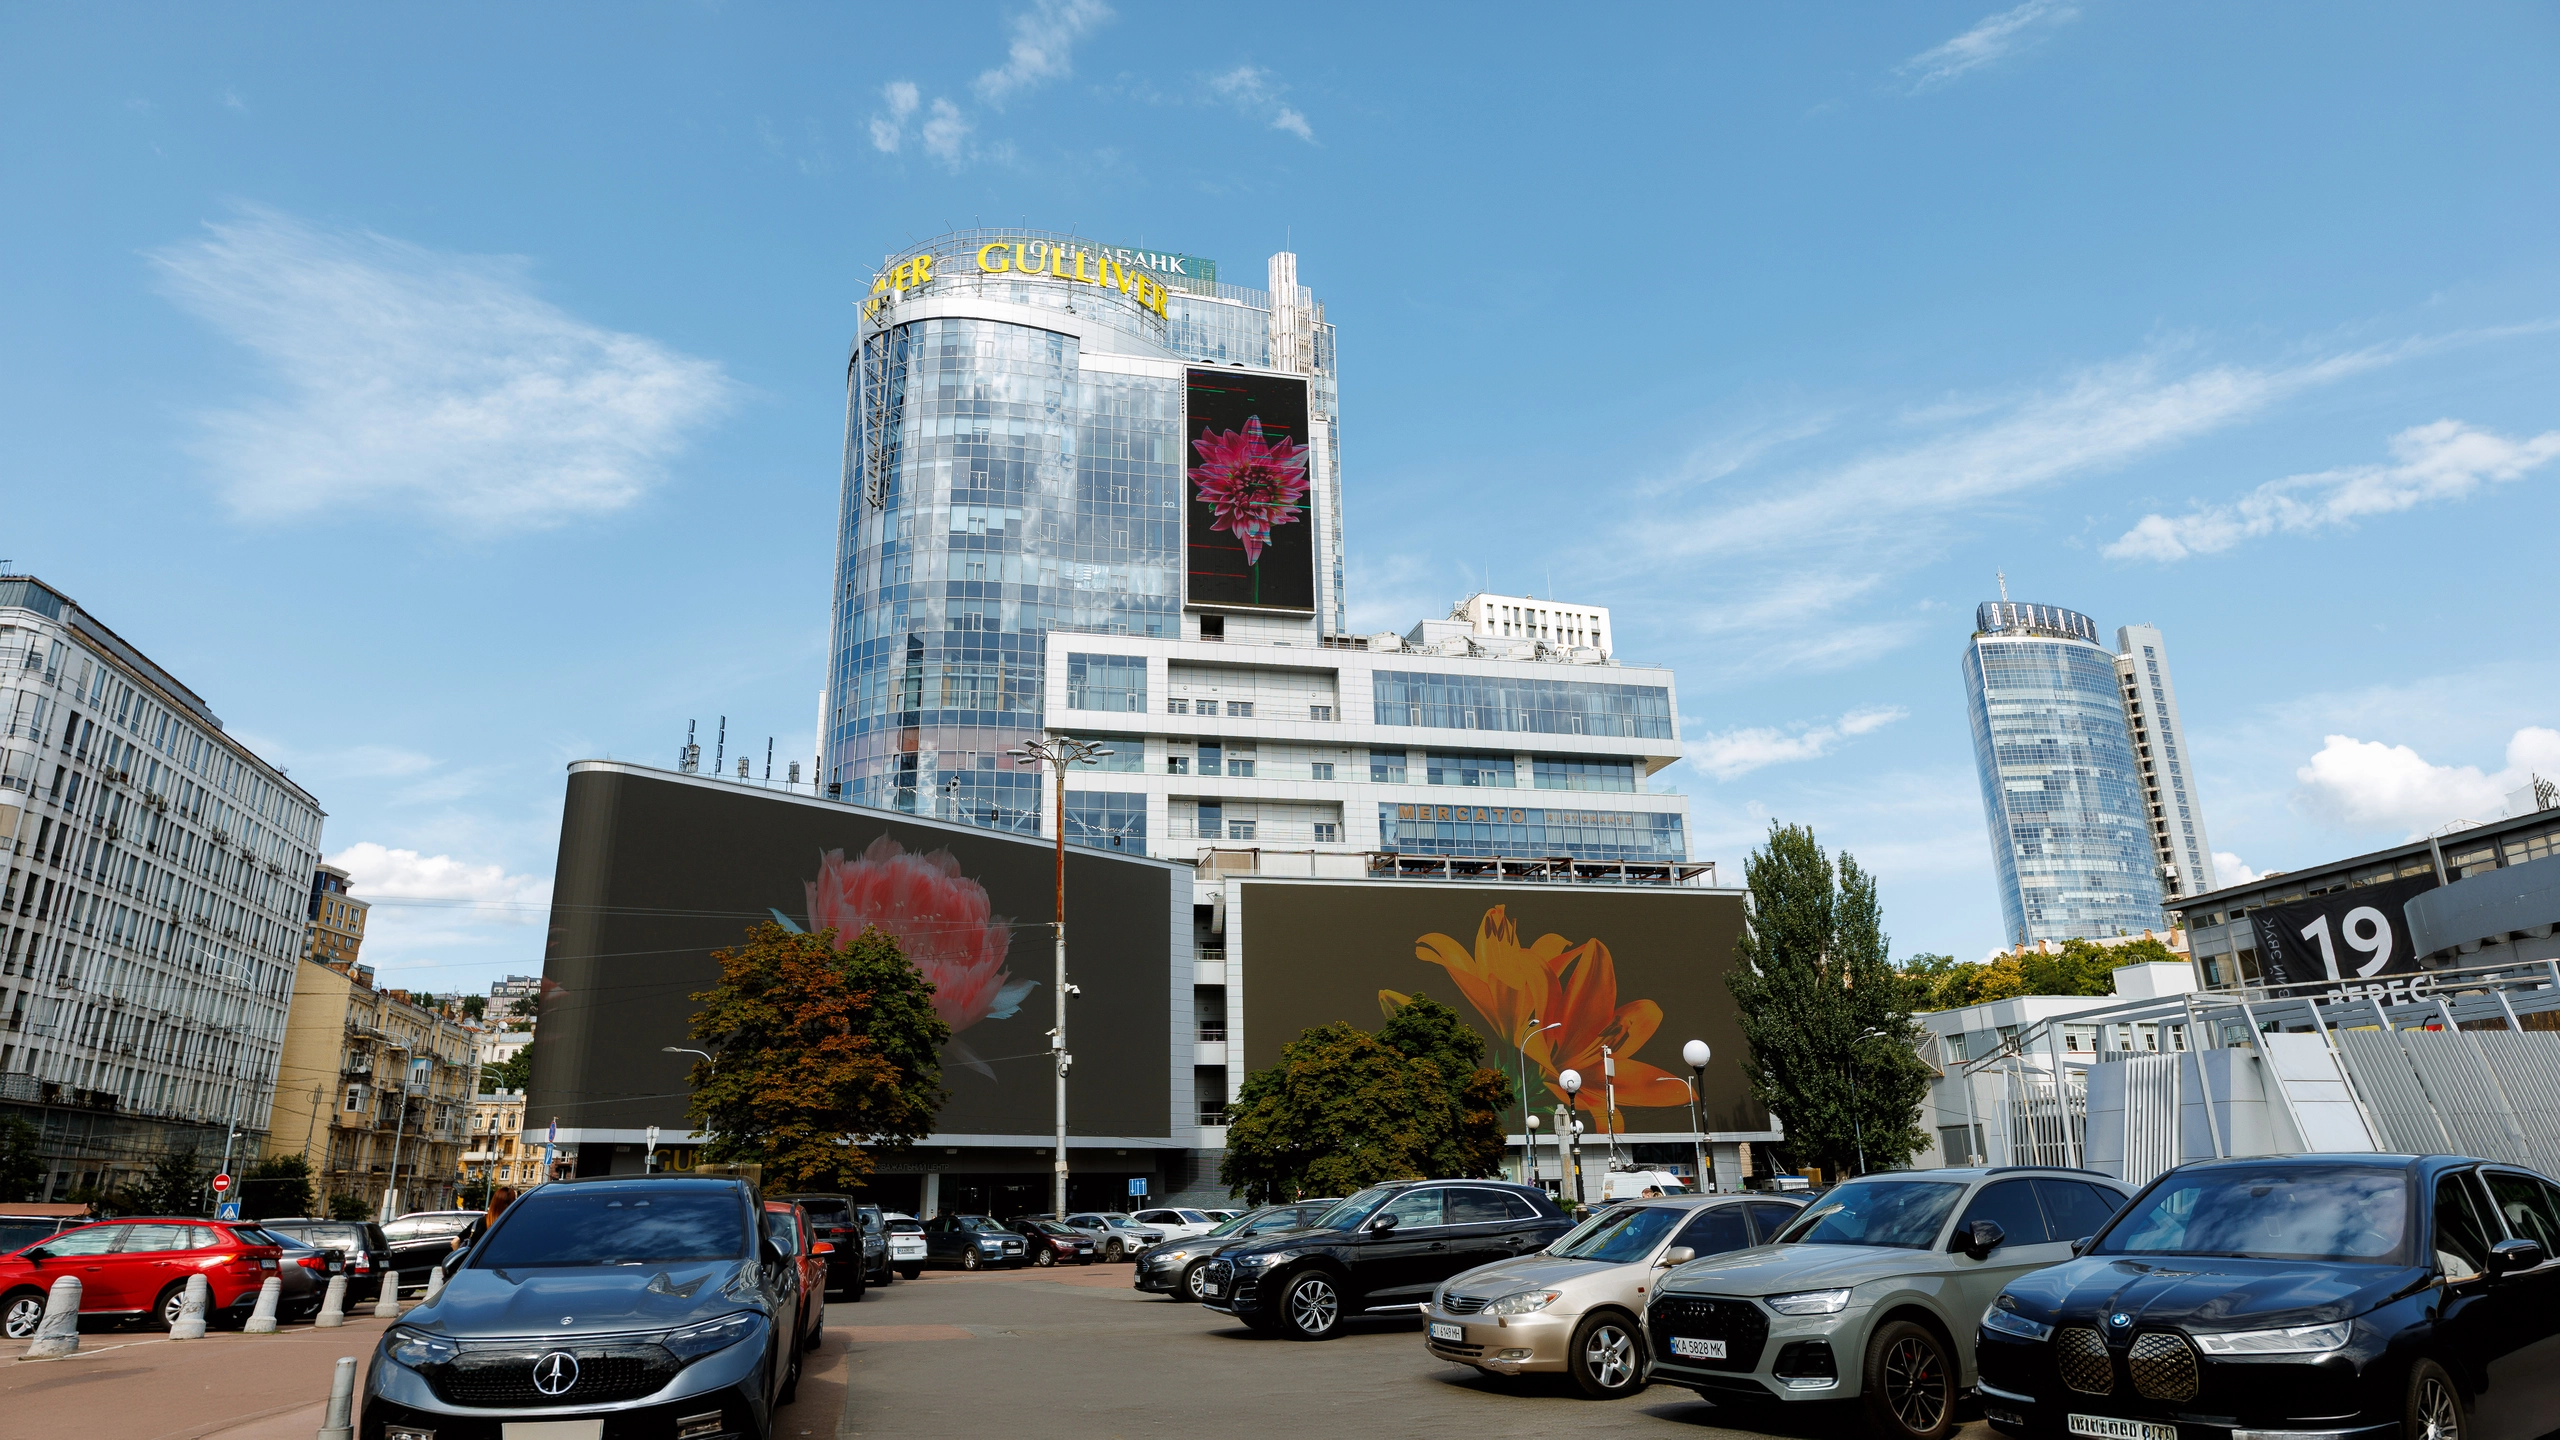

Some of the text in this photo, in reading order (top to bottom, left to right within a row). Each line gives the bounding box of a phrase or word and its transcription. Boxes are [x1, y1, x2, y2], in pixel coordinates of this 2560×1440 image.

[977, 243, 1168, 321] GULLIVER
[1399, 805, 1632, 825] MERCATO RISTORANTE
[2262, 917, 2282, 960] ЗВУК
[2300, 905, 2393, 981] 19
[1676, 1339, 1724, 1356] KA 5828 MK
